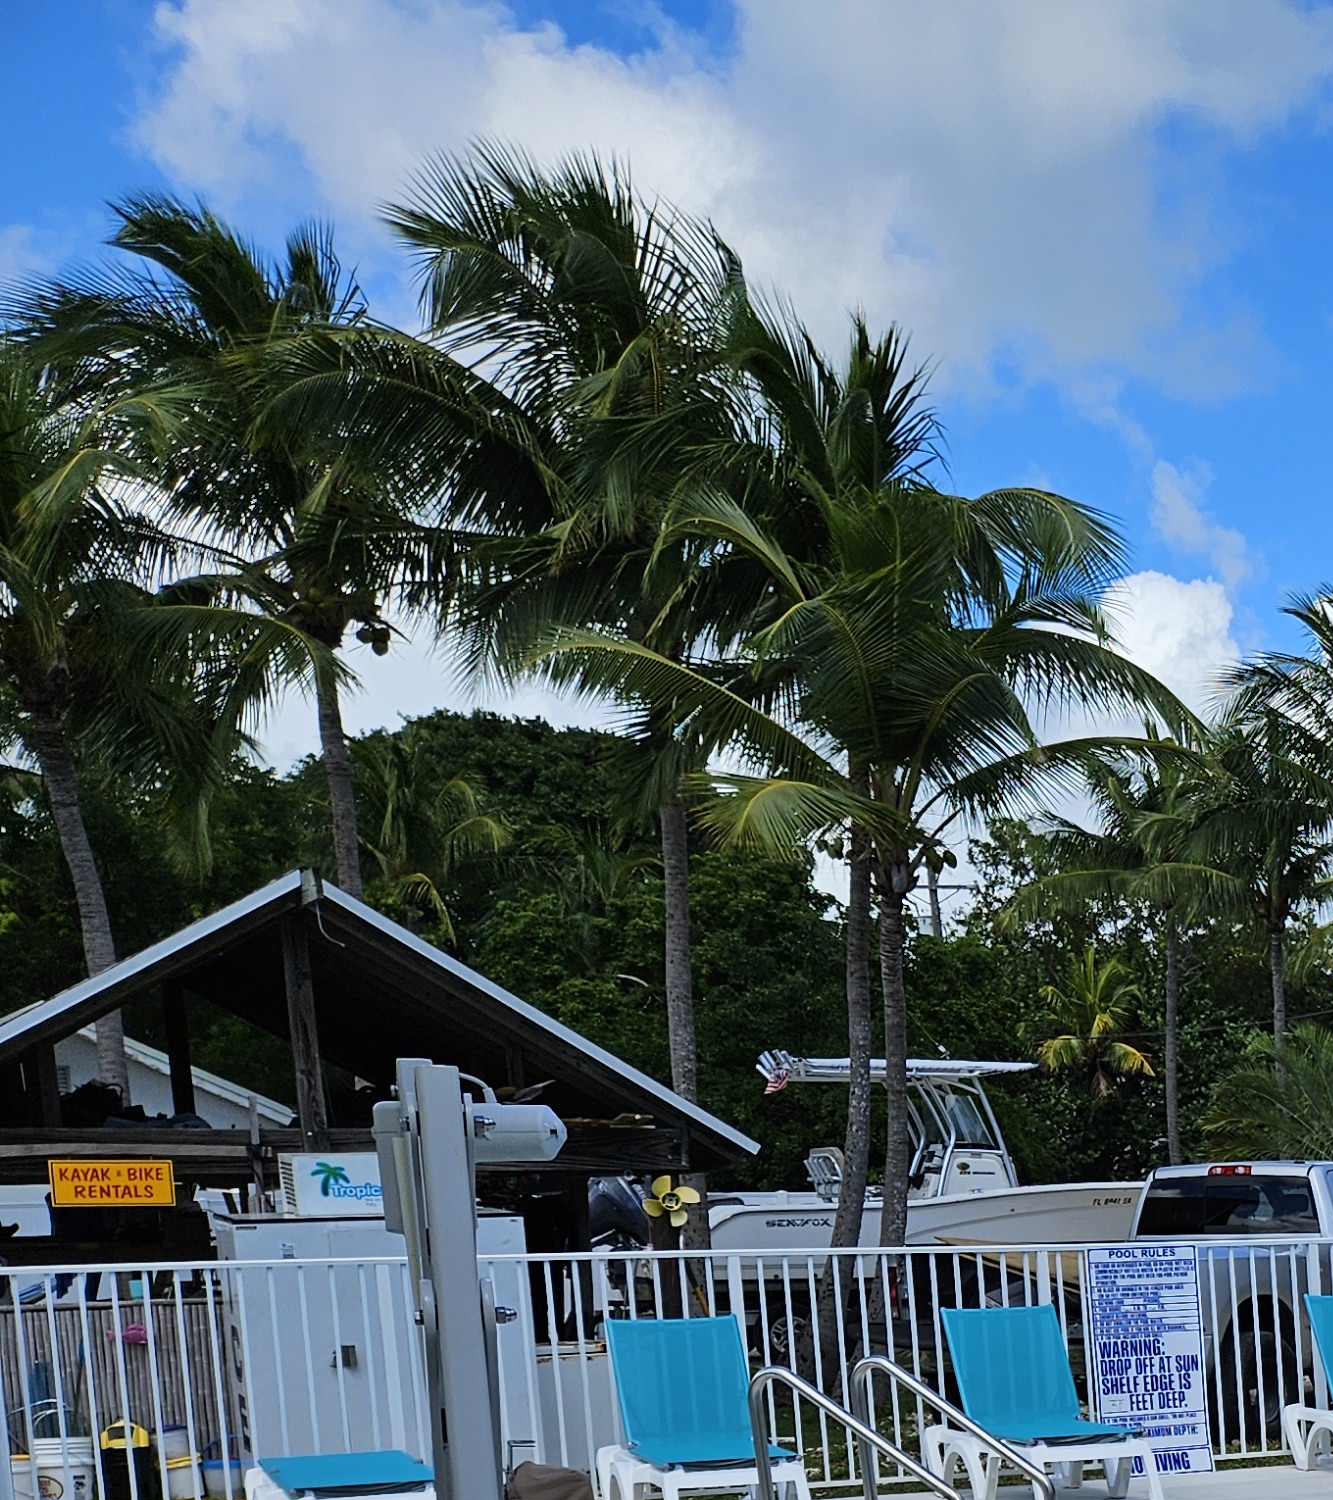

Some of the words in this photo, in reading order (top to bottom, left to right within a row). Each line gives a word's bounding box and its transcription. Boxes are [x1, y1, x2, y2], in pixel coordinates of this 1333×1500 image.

[58, 1167, 111, 1182] KAYAK
[127, 1167, 164, 1181] BIKE
[74, 1185, 154, 1199] RENTALS
[1108, 1249, 1138, 1259] POOL
[1141, 1248, 1176, 1258] RULES
[1098, 1338, 1165, 1359] WARNING:
[1100, 1358, 1132, 1377] DROP
[1135, 1356, 1155, 1375] OFF
[1158, 1355, 1172, 1374] AT
[1175, 1354, 1199, 1373] SUN
[1101, 1375, 1140, 1395] SHELF
[1142, 1373, 1175, 1393] EDGE
[1178, 1372, 1192, 1390] IS
[1129, 1393, 1155, 1411] FEET
[1157, 1391, 1188, 1410] DEEP.
